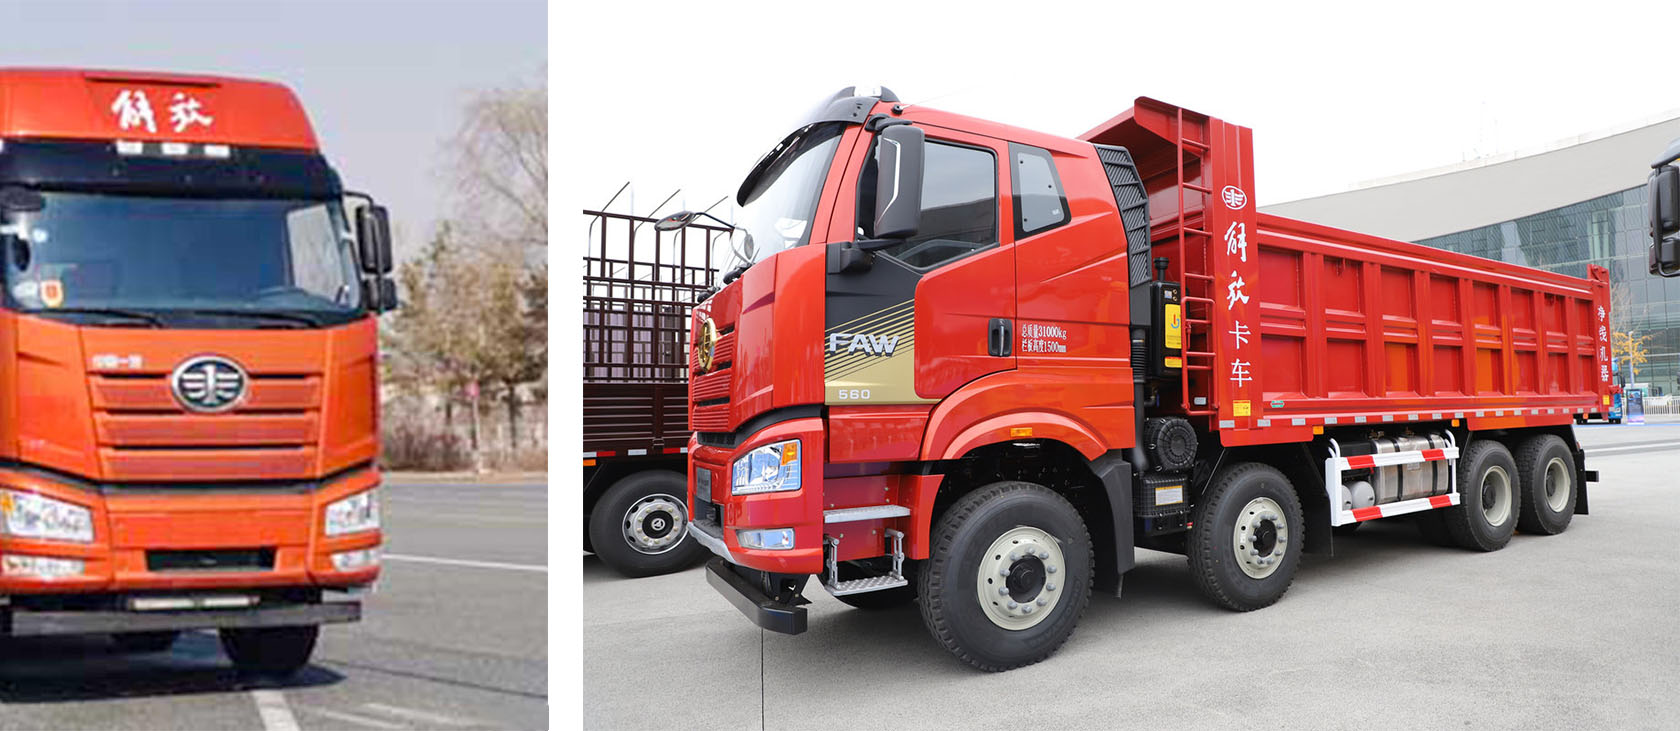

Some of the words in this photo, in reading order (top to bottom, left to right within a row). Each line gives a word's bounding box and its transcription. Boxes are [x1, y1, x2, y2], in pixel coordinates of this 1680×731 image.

[111, 89, 214, 133] 解放
[1224, 221, 1253, 388] 解放卡车
[829, 333, 900, 357] FAW
[838, 389, 871, 400] 560
